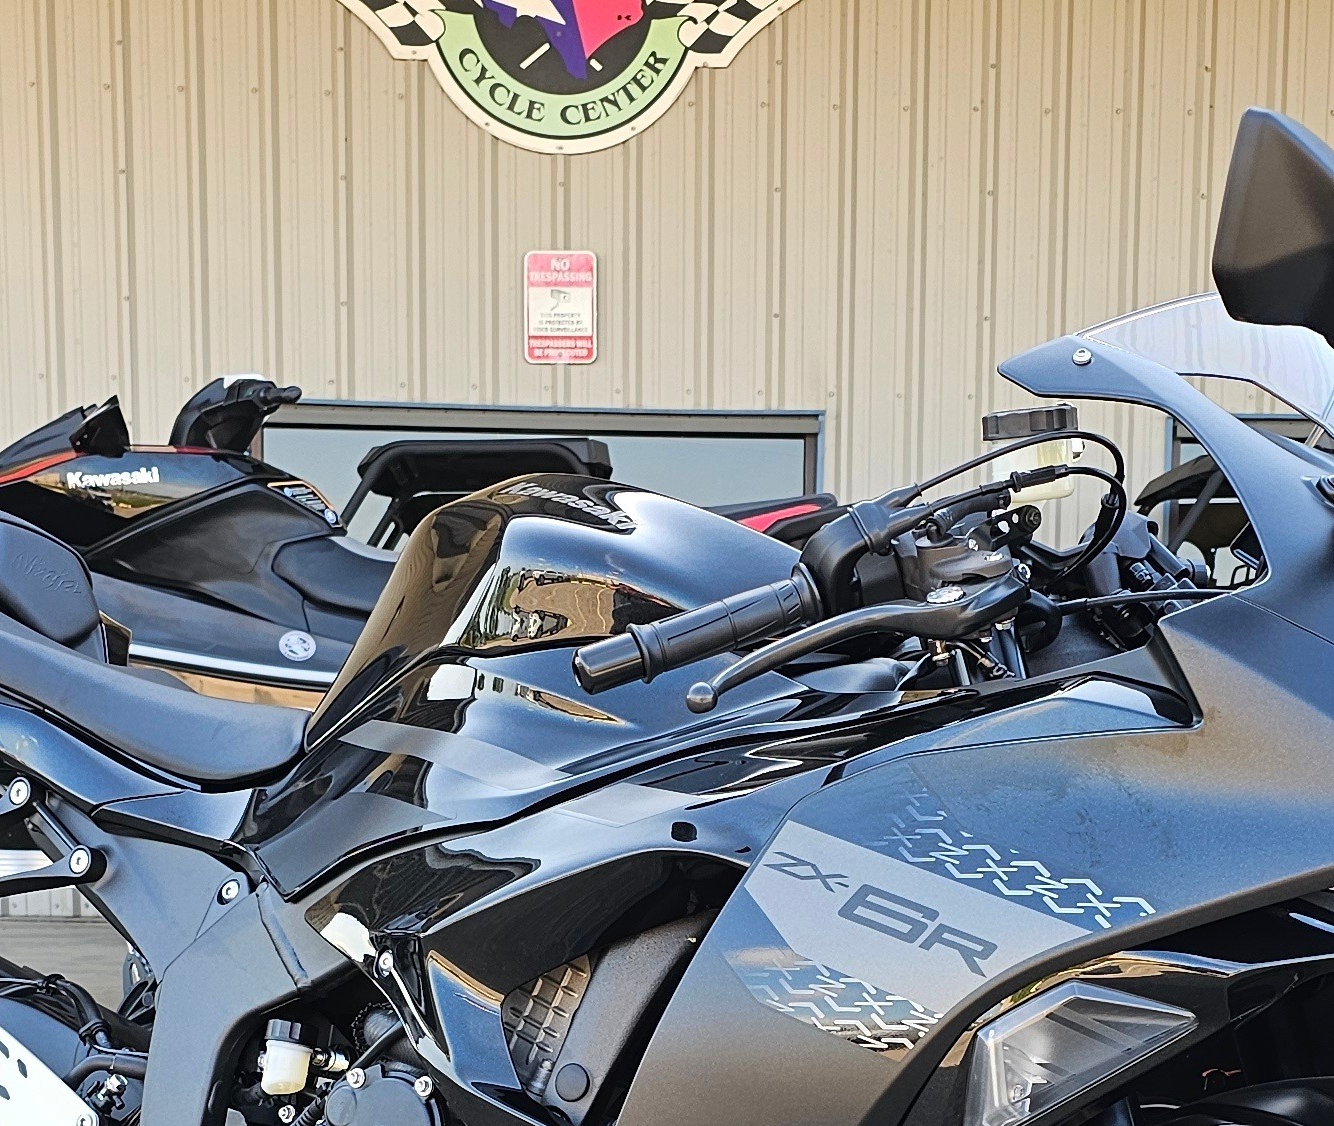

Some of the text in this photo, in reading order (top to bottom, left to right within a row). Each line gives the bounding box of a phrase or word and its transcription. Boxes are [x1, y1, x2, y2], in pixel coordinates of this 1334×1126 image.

[458, 47, 671, 126] CYCLE CENTER
[529, 271, 593, 282] TRESPASSING
[550, 258, 570, 271] NO
[66, 466, 160, 489] Kawasaki
[498, 482, 638, 530] Kawasaki
[11, 551, 82, 595] Ninja
[762, 850, 999, 979] ZX-6R
